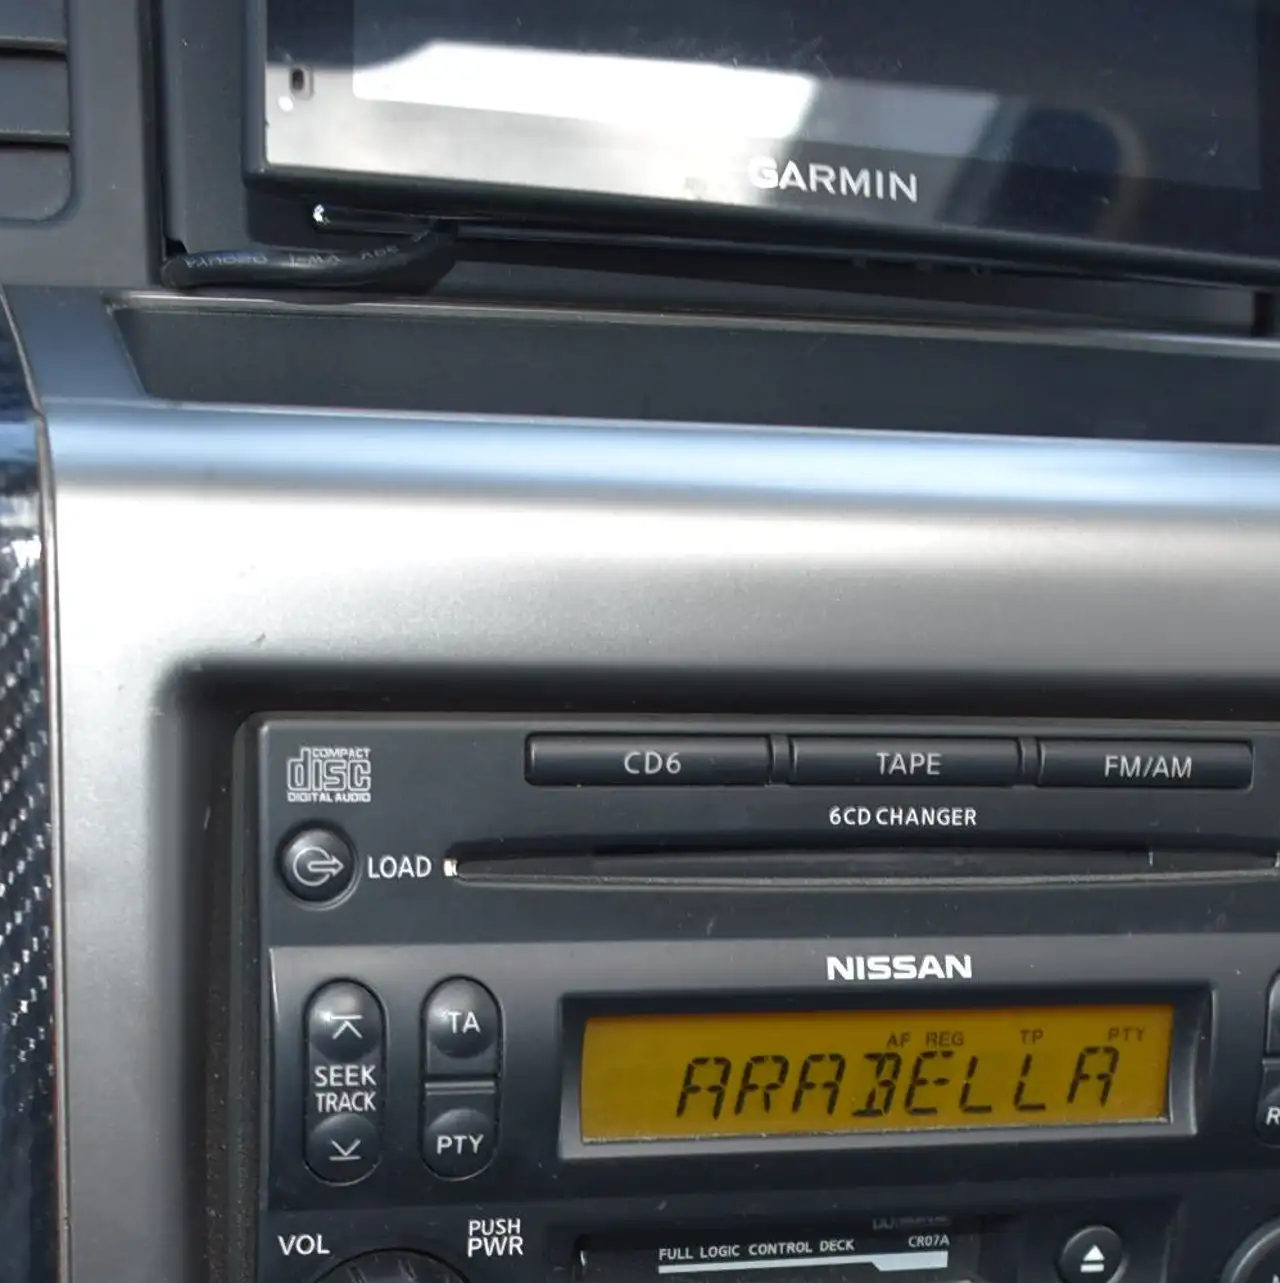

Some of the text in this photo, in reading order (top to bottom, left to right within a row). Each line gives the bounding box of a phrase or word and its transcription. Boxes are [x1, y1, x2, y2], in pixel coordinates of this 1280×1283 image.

[748, 156, 918, 203] GARMIN
[312, 747, 372, 759] COMPACT
[624, 751, 682, 776] CD6
[876, 752, 942, 776] TAPE
[1104, 753, 1193, 778] FM/AM
[286, 791, 372, 803] DIGITAL AUDIO
[875, 807, 977, 826] CHANGER
[367, 855, 432, 879] LOAD
[826, 954, 973, 981] NISSAN
[447, 1011, 482, 1035] TA
[886, 1027, 1146, 1049] AF REG TP PTY
[314, 1064, 377, 1087] SEEK
[675, 1045, 1120, 1120] ARABELLA
[315, 1091, 376, 1113] TRACK
[436, 1134, 484, 1155] PTY
[467, 1218, 522, 1236] PUSH
[277, 1233, 330, 1256] VOL
[466, 1235, 524, 1258] PWR
[658, 1239, 855, 1261] FULL LOGIC CONTROL DECK
[907, 1234, 950, 1248] CR07A
